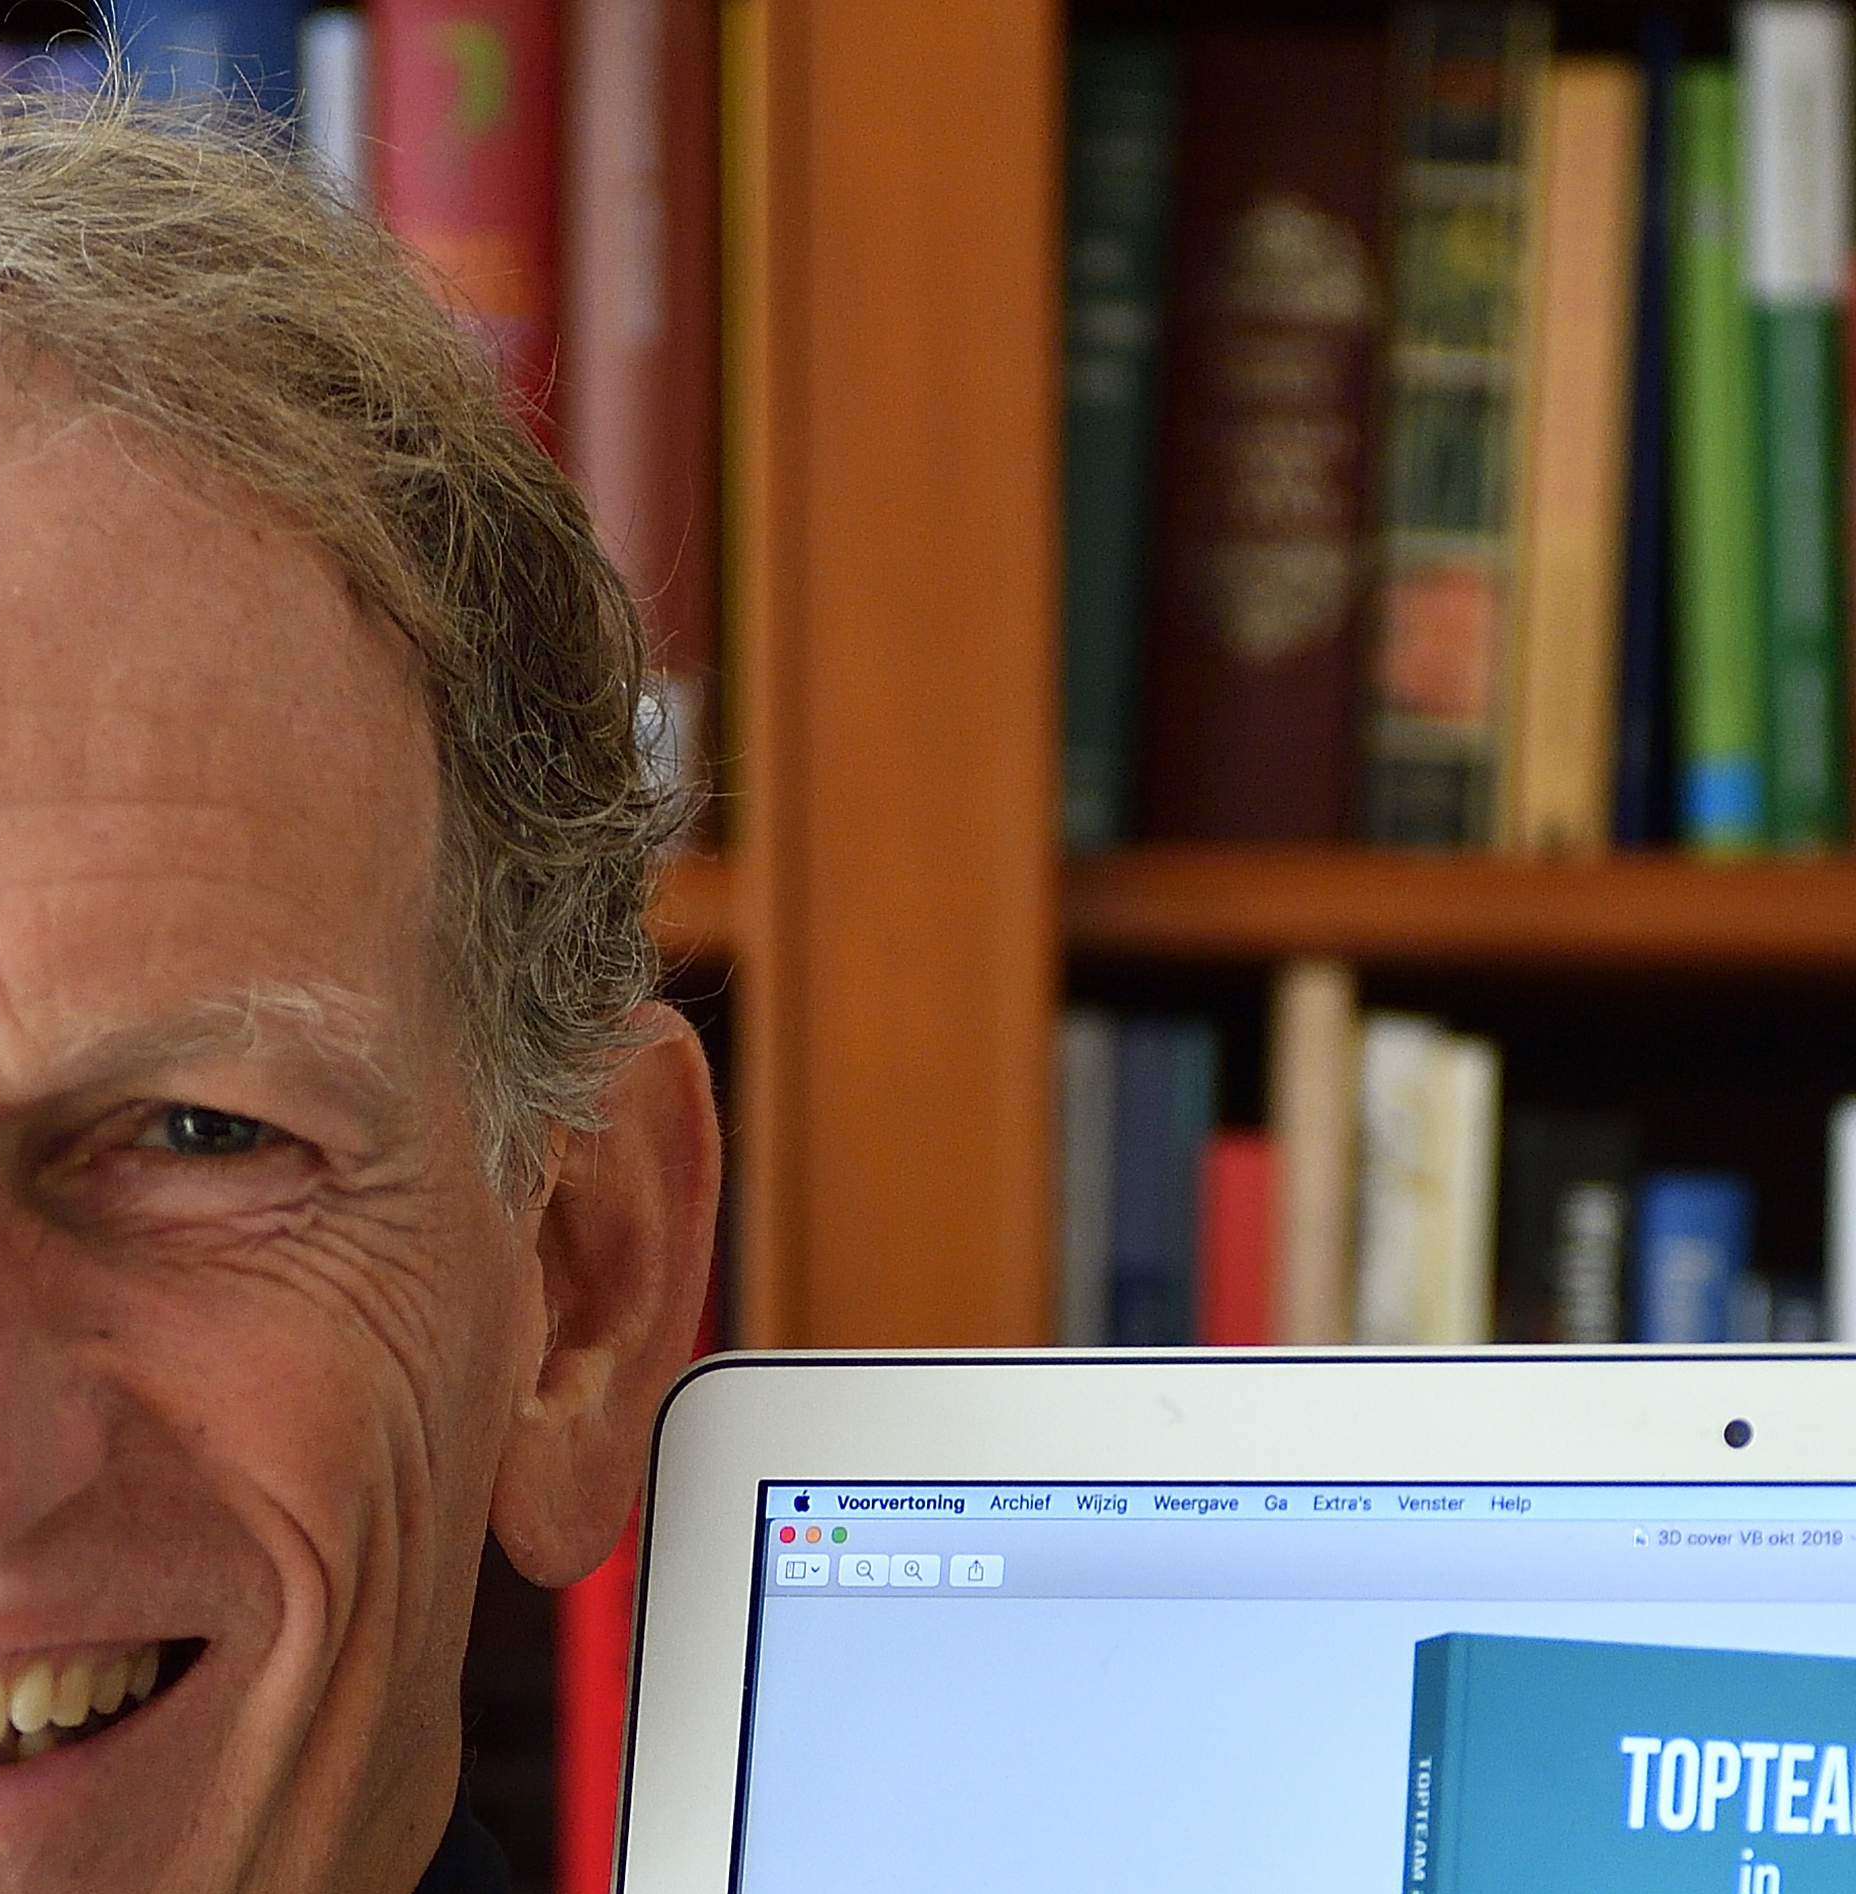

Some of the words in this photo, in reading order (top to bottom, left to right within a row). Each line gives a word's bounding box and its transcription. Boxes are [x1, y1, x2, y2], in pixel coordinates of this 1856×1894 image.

[837, 1494, 965, 1514] Voorvertoning
[990, 1494, 1051, 1511] Archief
[1077, 1495, 1128, 1514] Wijzig
[1154, 1495, 1239, 1514] Weergave
[1265, 1495, 1288, 1511] Ga
[1313, 1495, 1372, 1511] Extra's
[1398, 1495, 1465, 1511] Venster
[1491, 1495, 1532, 1514] Help
[1659, 1530, 1682, 1546] 3D
[1688, 1533, 1732, 1546] cover
[1740, 1531, 1763, 1546] VB
[1769, 1531, 1794, 1546] okt
[1802, 1531, 1843, 1546] 2019
[1412, 1756, 1433, 1882] TOPTEAM
